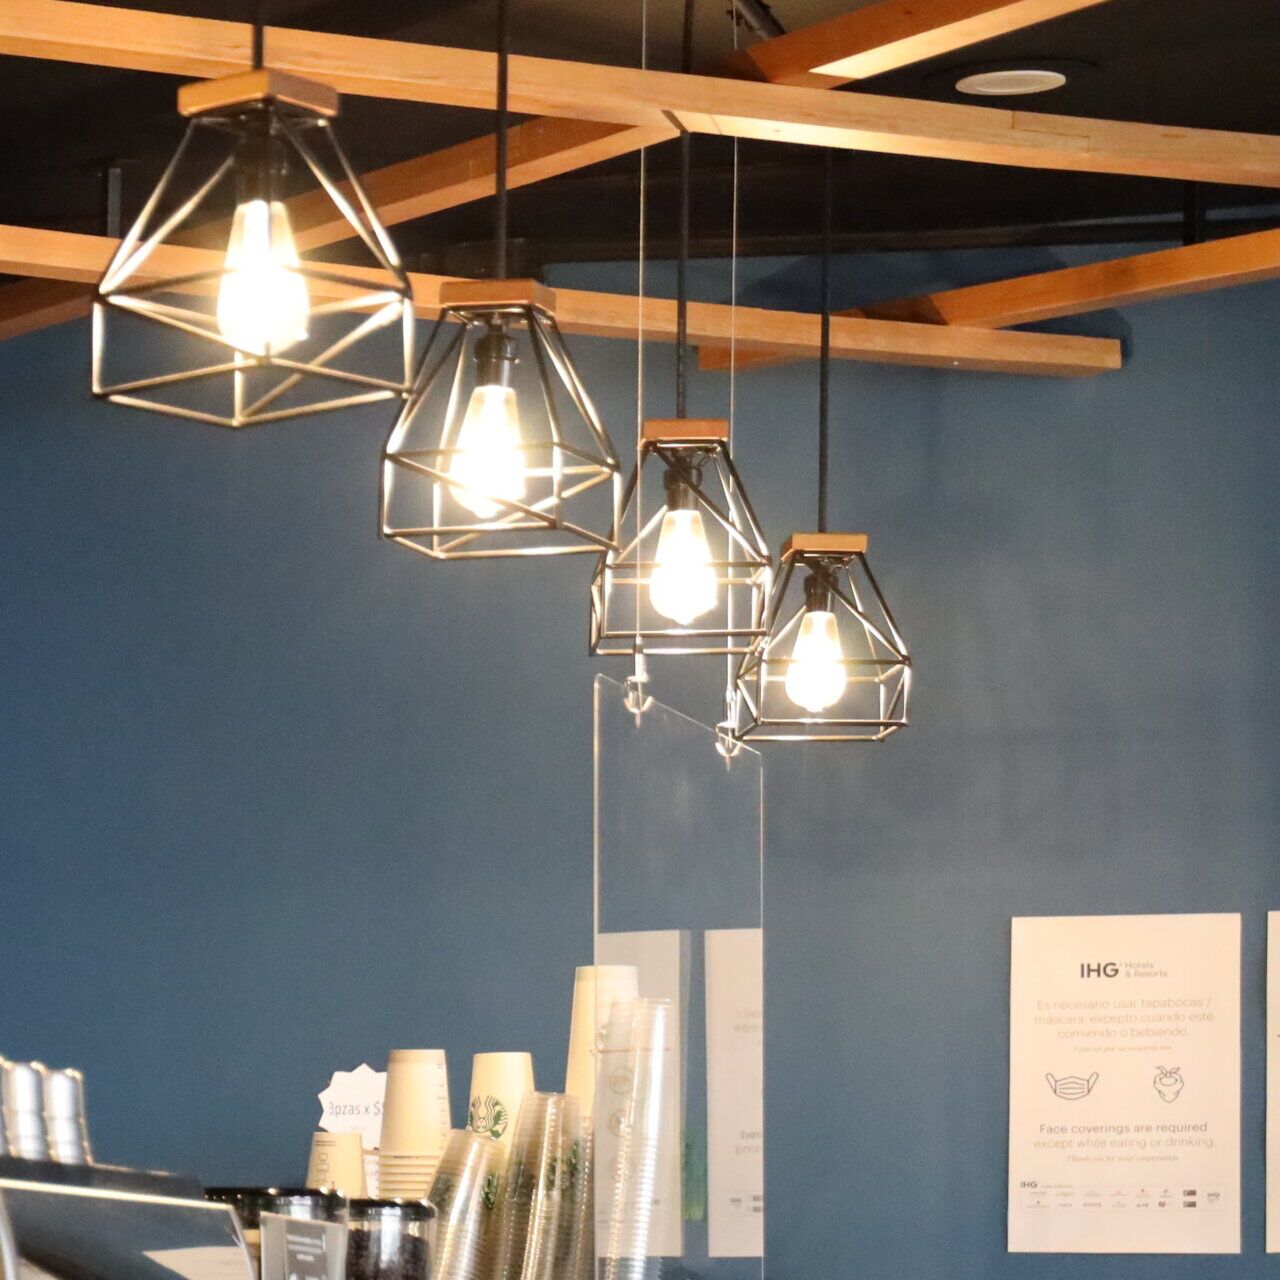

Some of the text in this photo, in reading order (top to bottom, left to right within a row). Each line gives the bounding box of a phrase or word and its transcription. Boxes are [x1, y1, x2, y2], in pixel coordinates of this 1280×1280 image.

[1080, 962, 1120, 979] IHG
[1124, 961, 1154, 969] Hotels
[1134, 969, 1168, 978] Resorts
[1037, 996, 1204, 1012] Es necesario usar tapabocas
[1089, 1012, 1138, 1027] excepto
[1140, 1011, 1186, 1024] cuando
[1188, 1010, 1215, 1022] esté
[1057, 1025, 1188, 1039] comiendo o bebiendo
[328, 1101, 370, 1117] 3pzas x
[1039, 1121, 1208, 1136] Face coverings are required
[1033, 1136, 1214, 1151] except while eating or drinking
